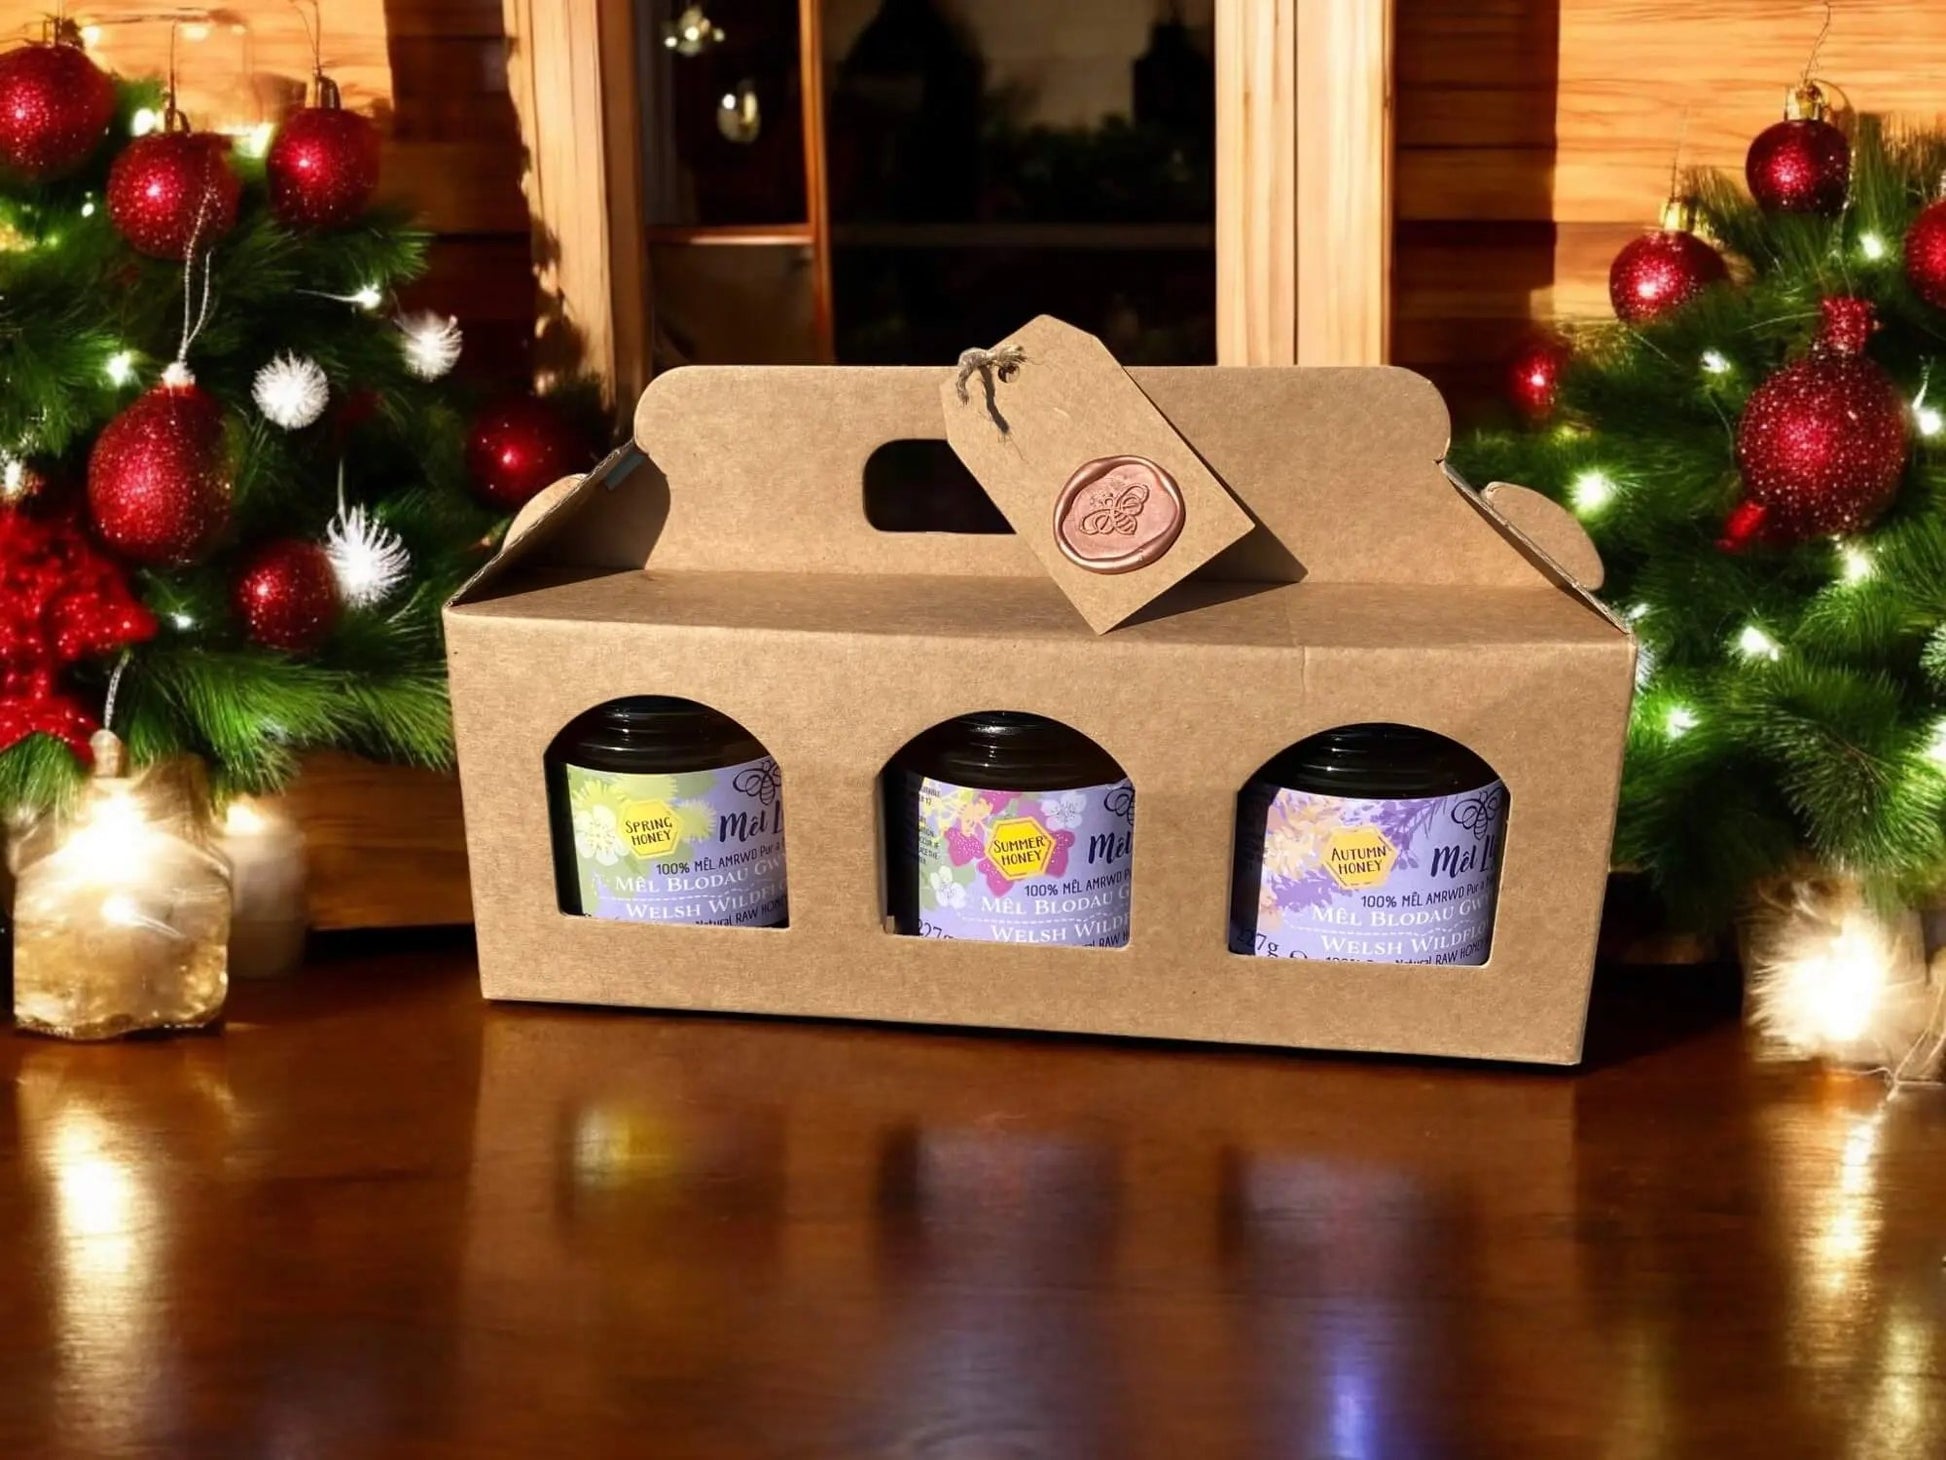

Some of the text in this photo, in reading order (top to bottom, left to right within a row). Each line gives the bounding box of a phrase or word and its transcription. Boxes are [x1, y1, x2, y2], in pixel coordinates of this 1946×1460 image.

[625, 817, 673, 834] SPRING
[719, 811, 767, 843] Mêl
[631, 830, 672, 846] HONEY
[994, 836, 1045, 853] SUMMER
[1088, 830, 1132, 865] Mêl
[656, 862, 690, 876] 100%
[694, 857, 716, 872] MÊL
[718, 848, 757, 868] AMRWD
[1002, 849, 1042, 866] HONEY
[1331, 845, 1387, 862] AUTUMN
[1430, 844, 1478, 878] Mêl
[1338, 859, 1383, 875] HONEY
[615, 875, 660, 894] MÊL
[667, 867, 749, 893] BLODAU
[1025, 883, 1058, 897] 100%
[1062, 878, 1083, 895] MÊL
[1086, 871, 1122, 892] AMRWD
[981, 895, 1028, 916] MÊL
[1035, 891, 1113, 916] BLODAU
[1361, 895, 1397, 908] 100%
[1401, 890, 1422, 907] MÊL
[1426, 885, 1464, 905] AMRWD
[625, 902, 701, 920] WELSH
[735, 907, 758, 924] RAW
[1312, 905, 1362, 926] MÊL
[1369, 906, 1454, 927] BLODAU
[991, 924, 1066, 943] WELSH
[1320, 934, 1402, 956] WELSH
[1435, 949, 1458, 966] RAW
